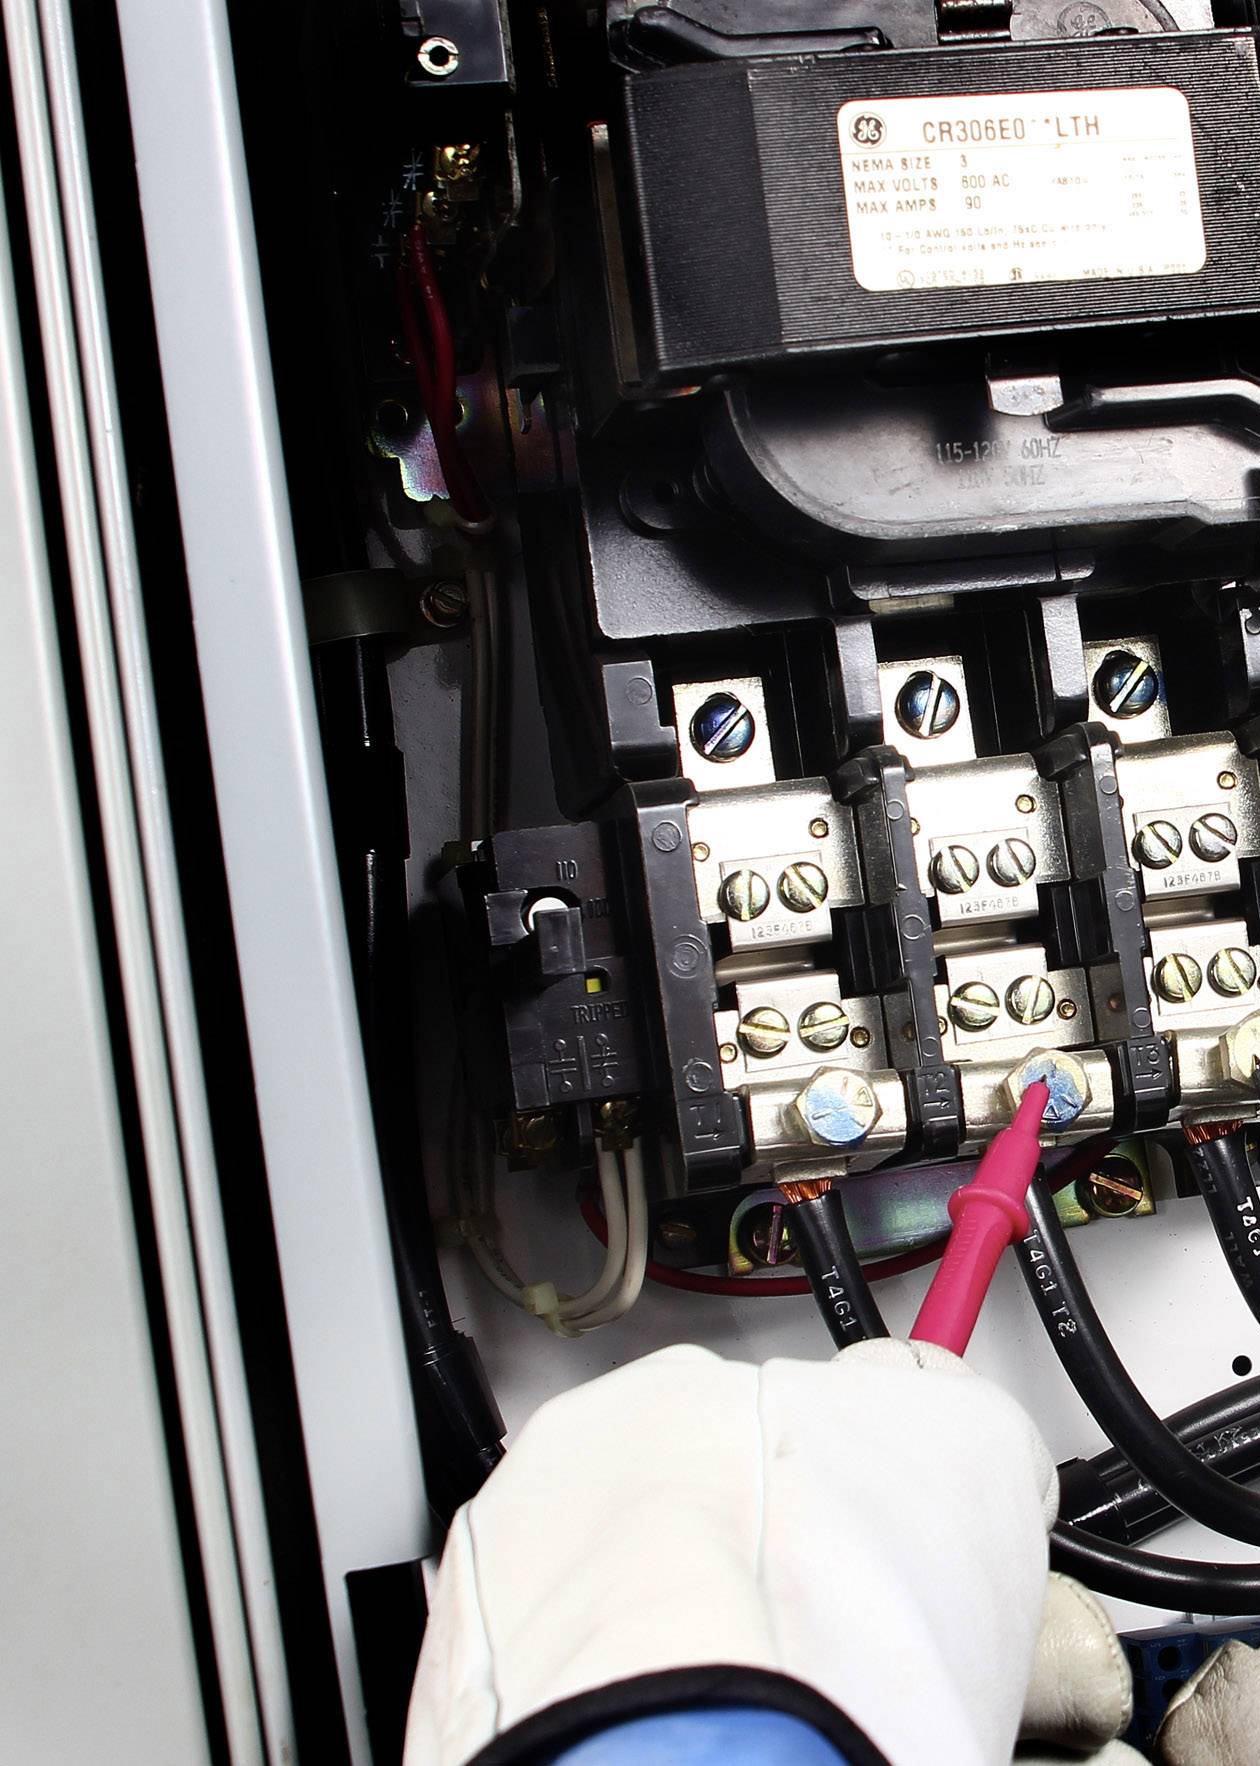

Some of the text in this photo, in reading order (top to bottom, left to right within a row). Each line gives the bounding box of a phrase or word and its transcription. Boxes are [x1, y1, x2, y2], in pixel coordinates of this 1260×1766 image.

[852, 156, 931, 172] NEMA SIZE
[960, 154, 968, 168] 3
[854, 177, 938, 194] MAX VOLTS
[993, 173, 1010, 188] AC
[856, 198, 937, 215] MAX AMPS
[965, 196, 981, 210] 90
[1020, 436, 1062, 460] 60HZ
[1023, 1228, 1058, 1297] T4G1
[821, 1265, 857, 1331] T4G1
